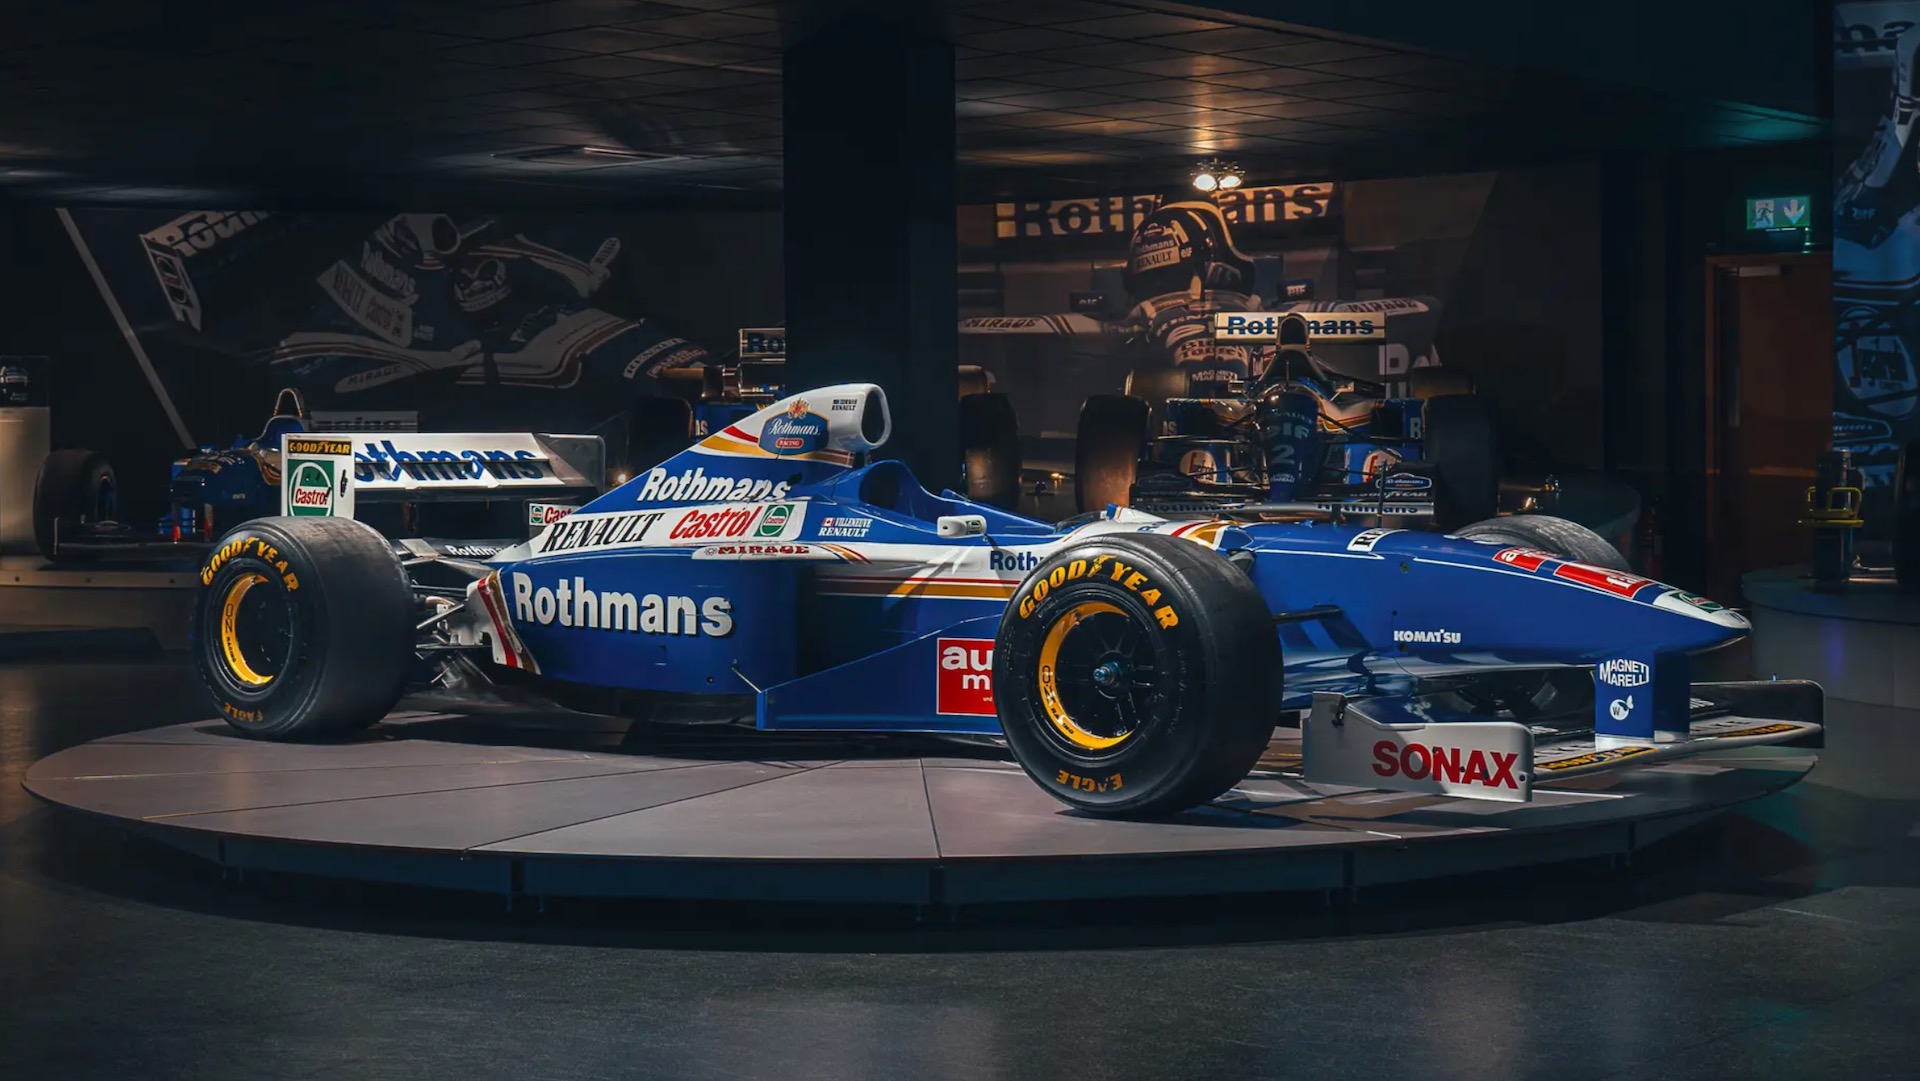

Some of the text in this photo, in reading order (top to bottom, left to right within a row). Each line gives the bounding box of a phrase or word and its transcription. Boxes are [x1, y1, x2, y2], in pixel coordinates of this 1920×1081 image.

[1018, 183, 1325, 236] Rothans
[965, 317, 1040, 328] MIRAGE
[1227, 316, 1375, 336] Rotmans
[348, 362, 402, 385] MIRAGE
[768, 418, 822, 438] Rothmans
[778, 439, 801, 448] RACING
[1270, 443, 1296, 465] 2
[637, 467, 791, 503] Rothmans
[541, 513, 664, 553] RENAULT
[669, 505, 762, 540] Castrol
[818, 527, 869, 538] RENAULT
[834, 518, 873, 528] VILLENEUVE
[718, 546, 810, 555] MIRAGE
[512, 571, 733, 637] Rothmans
[1393, 629, 1461, 644] KOMATSU
[1372, 740, 1518, 789] SONAX
